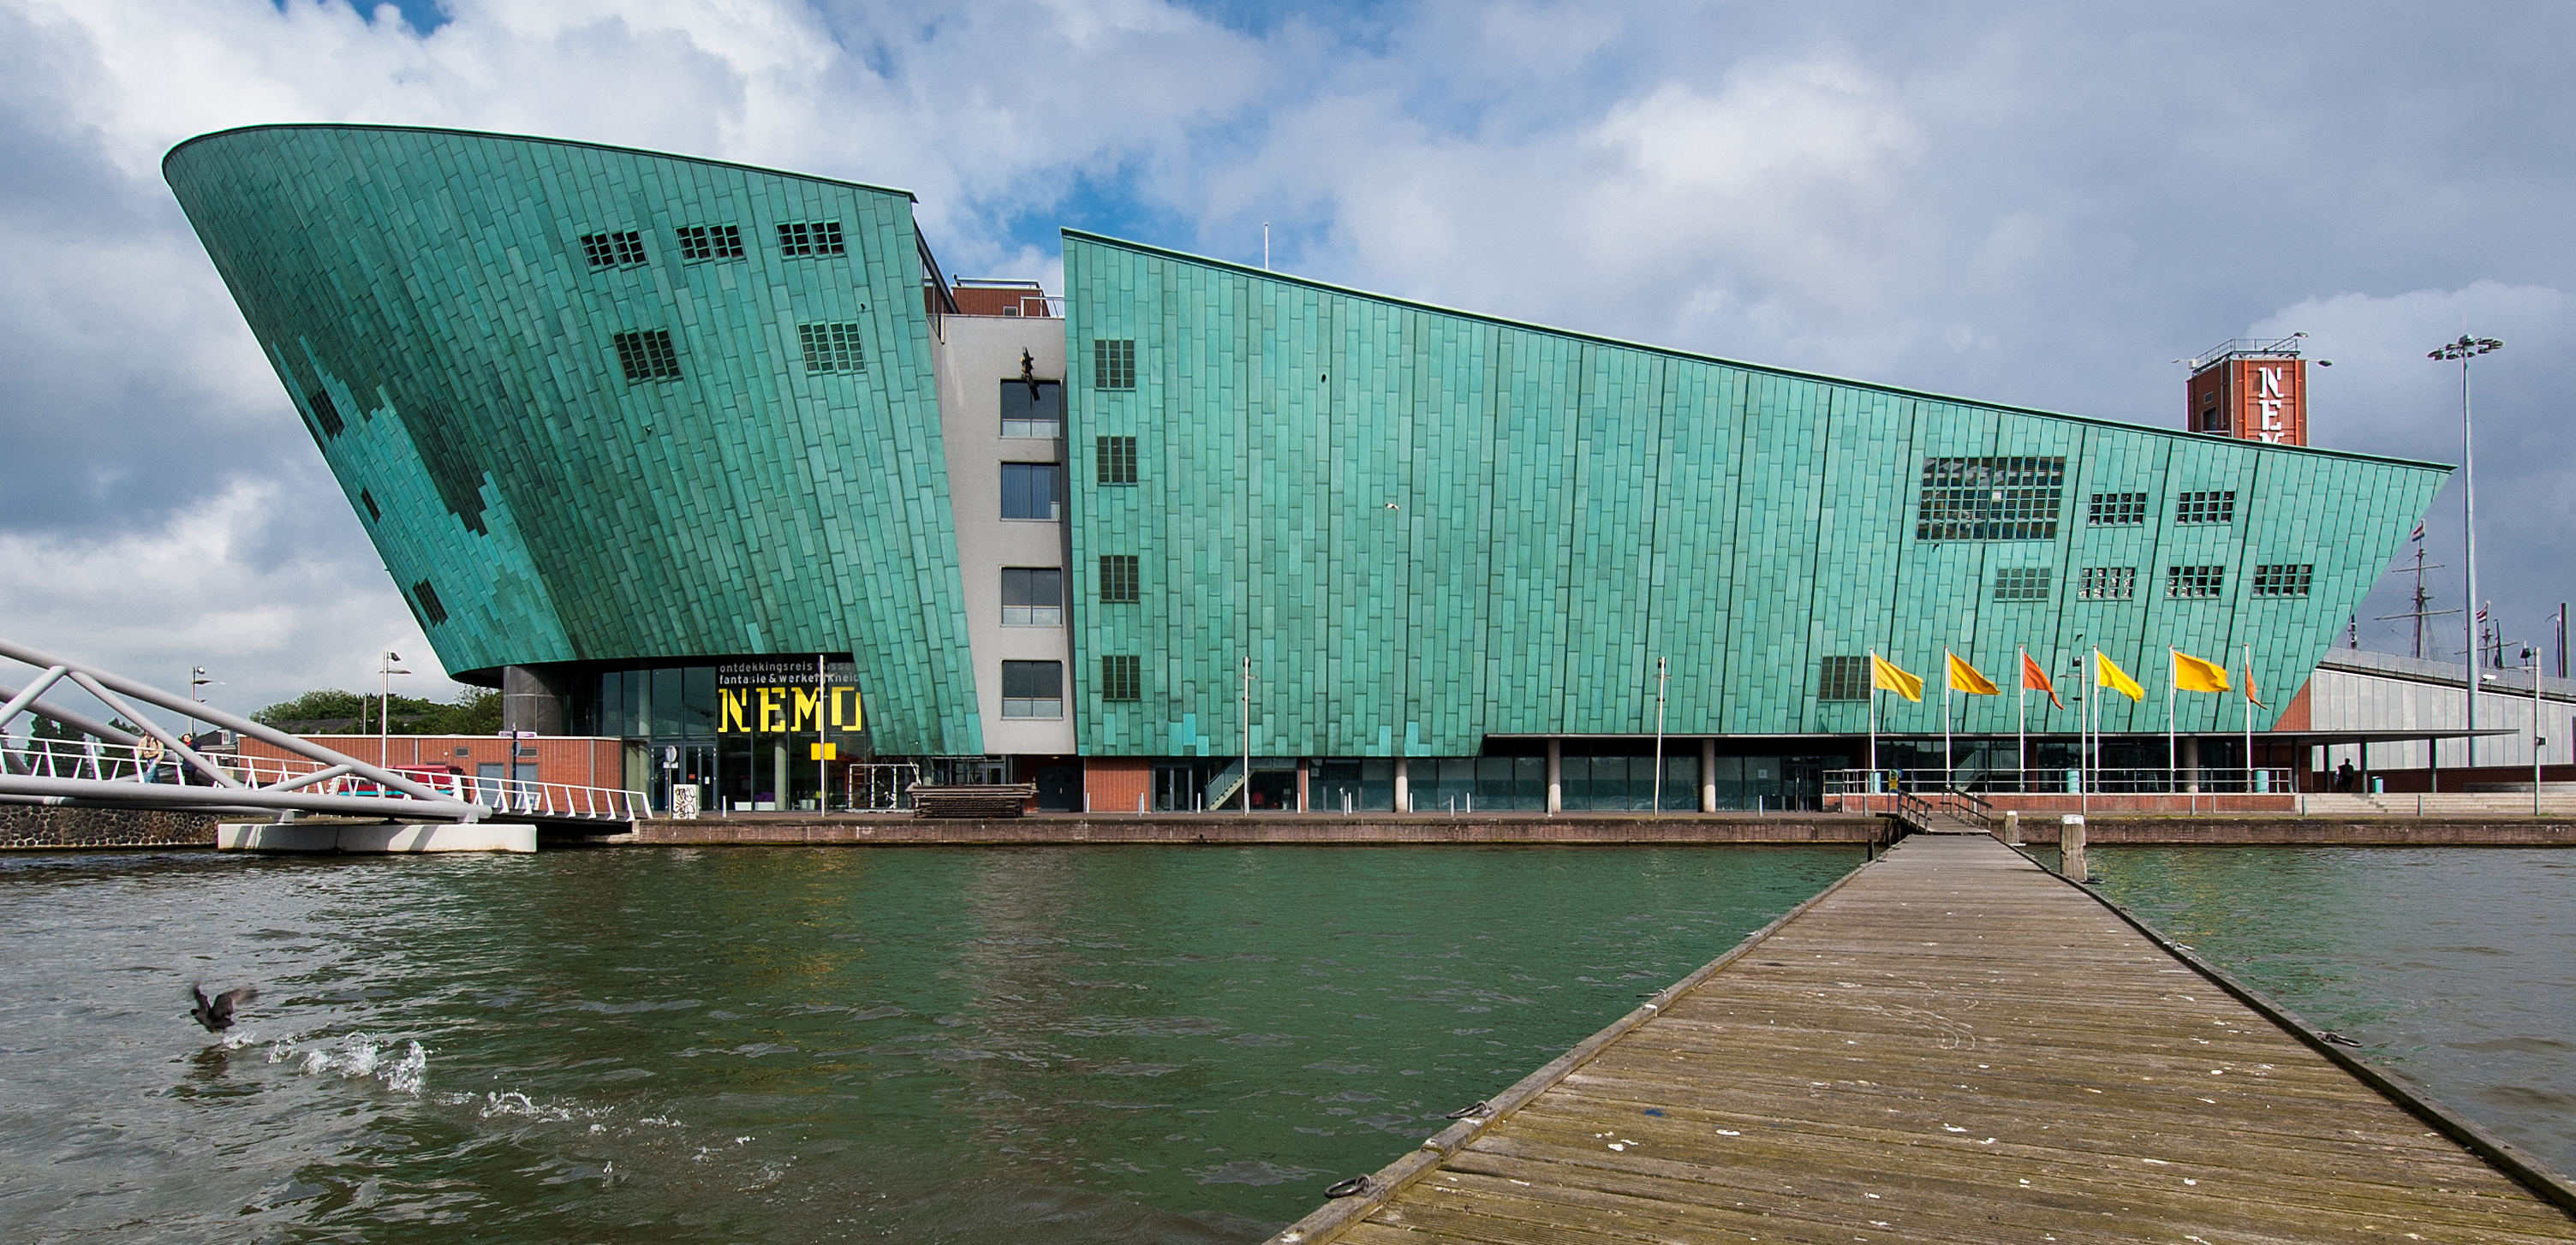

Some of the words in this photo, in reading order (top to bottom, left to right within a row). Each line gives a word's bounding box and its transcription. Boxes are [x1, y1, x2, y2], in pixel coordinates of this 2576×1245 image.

[719, 661, 813, 673] ontdekkingsreis
[719, 674, 766, 684] fantasie
[768, 673, 776, 683] &
[718, 686, 862, 733] NEMO
